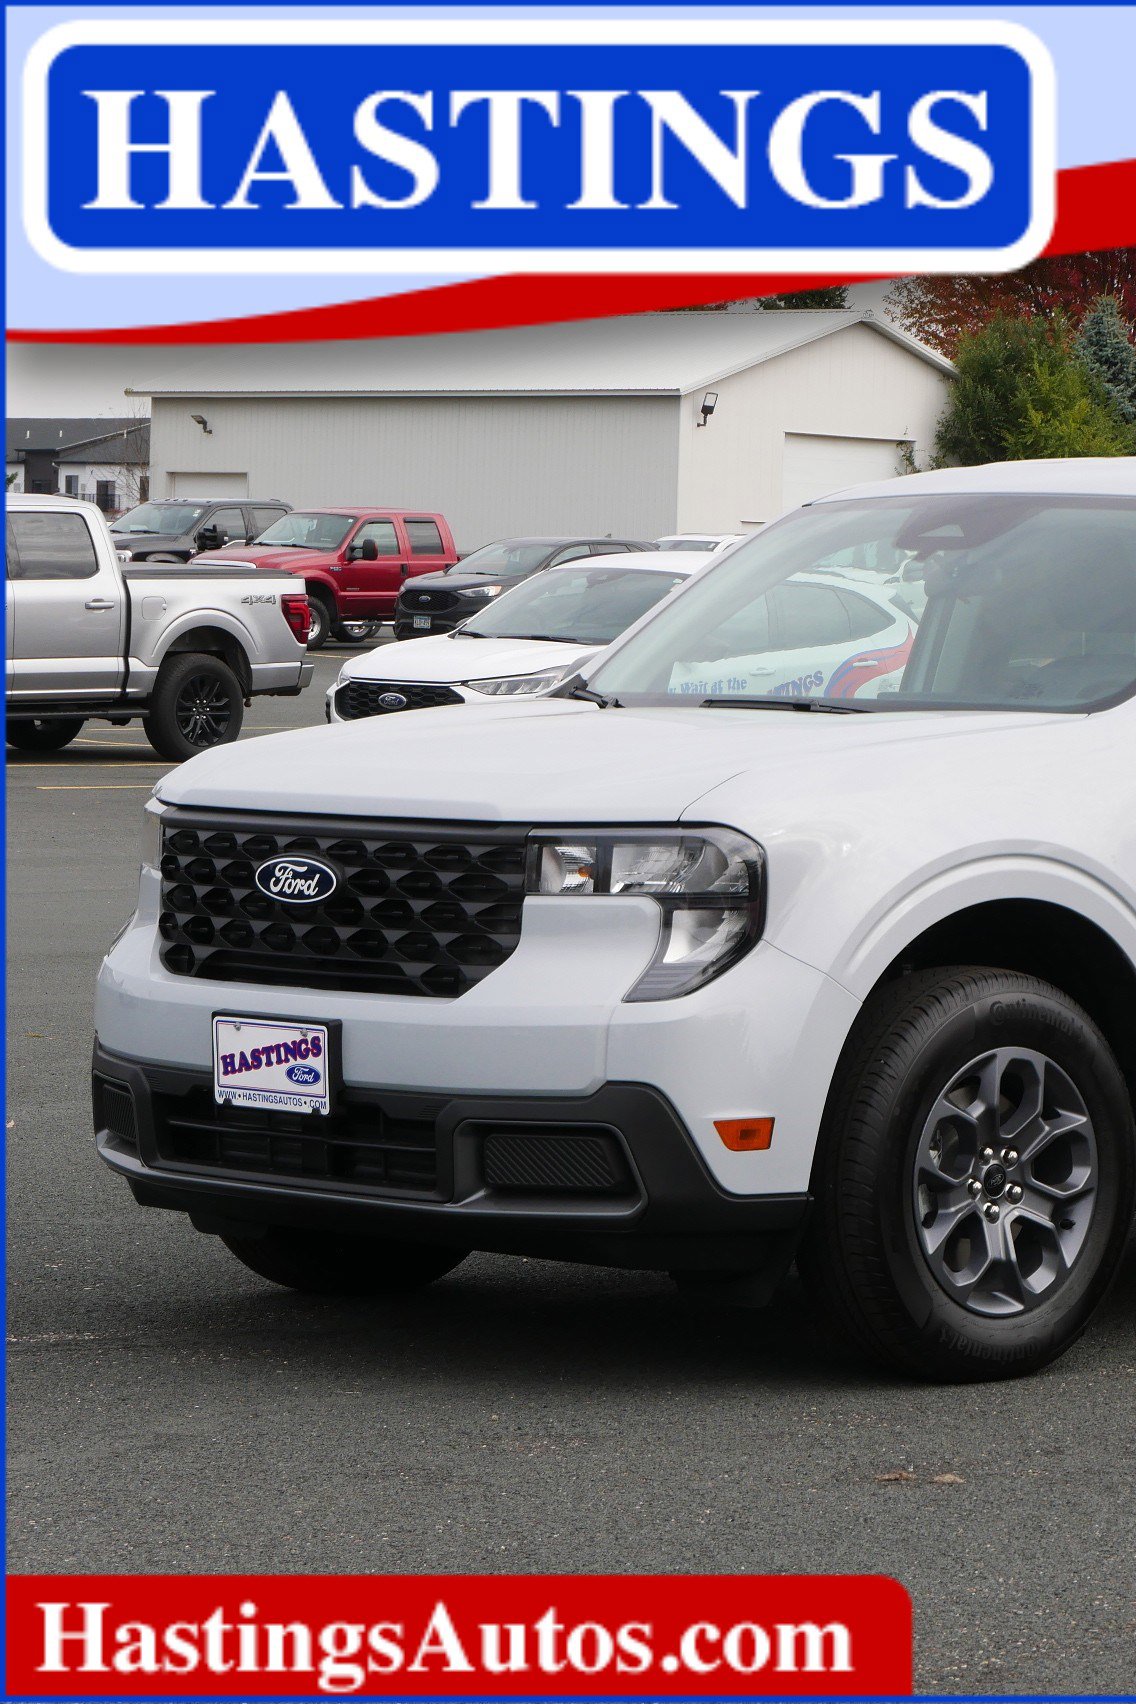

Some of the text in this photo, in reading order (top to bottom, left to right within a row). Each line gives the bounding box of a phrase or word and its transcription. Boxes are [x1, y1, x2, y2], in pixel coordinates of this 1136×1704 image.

[727, 677, 747, 690] the
[270, 863, 320, 896] Ford
[220, 1035, 323, 1077] HASTINGS
[292, 1066, 315, 1083] Ford
